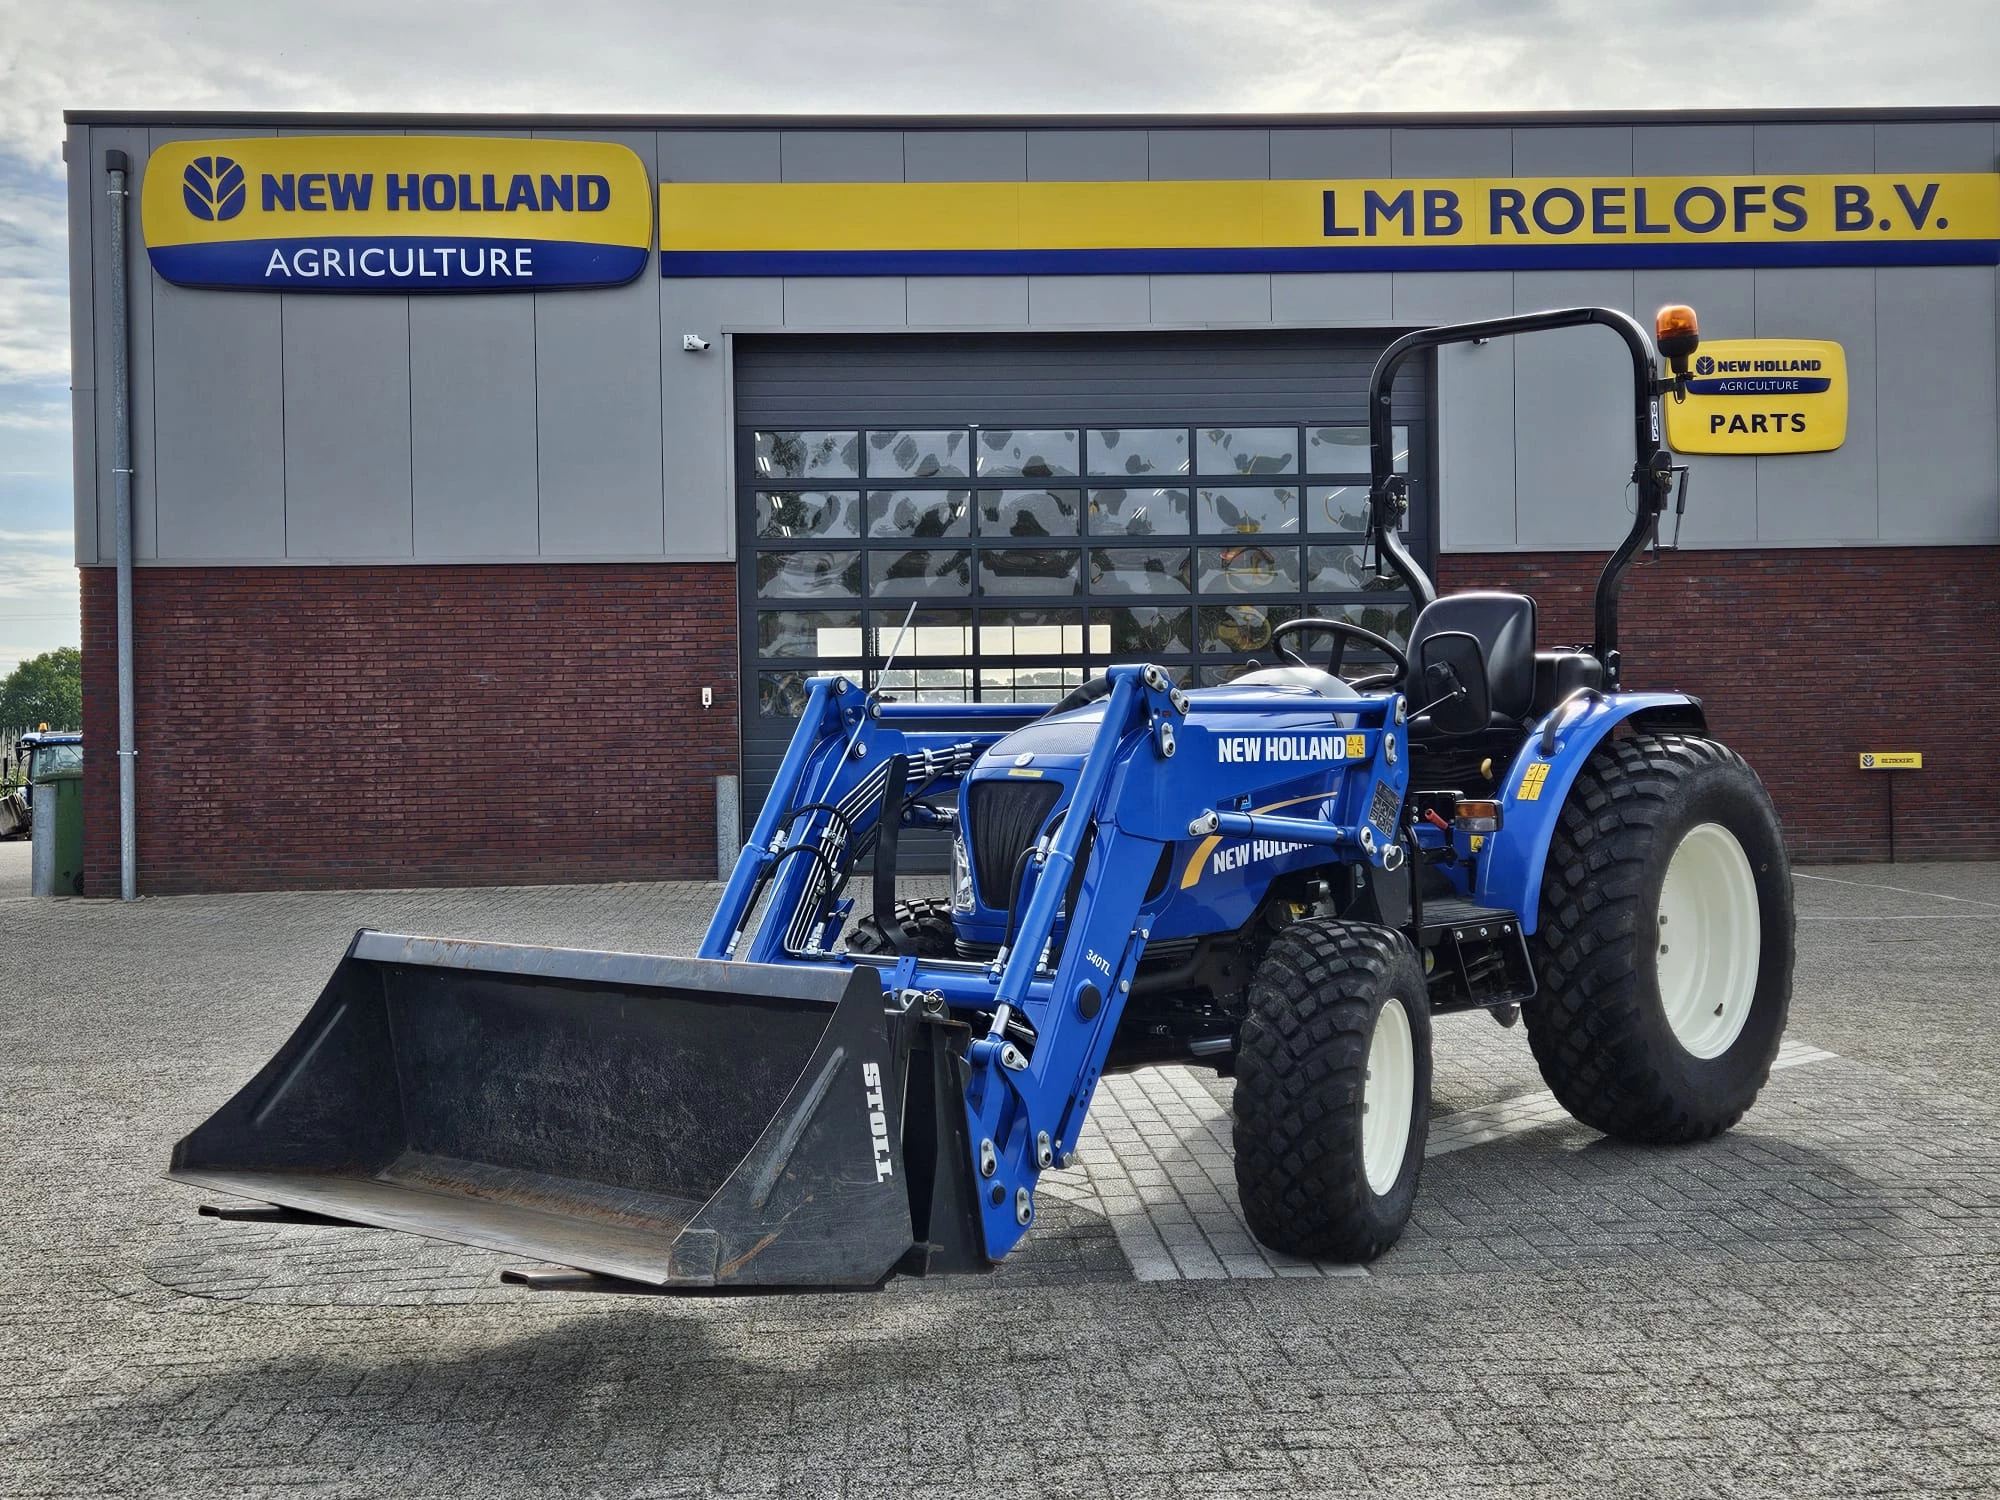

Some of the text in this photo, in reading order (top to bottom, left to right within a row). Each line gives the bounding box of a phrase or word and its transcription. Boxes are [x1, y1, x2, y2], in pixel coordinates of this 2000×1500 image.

[262, 174, 611, 213] NEW HOLLAND
[1322, 183, 1950, 237] LMB ROELOFS B.V.
[265, 248, 533, 277] AGRICULTURE
[1717, 359, 1822, 373] NEW HOLLAND
[1719, 380, 1799, 391] AGRICULTURE
[1710, 413, 1806, 434] PARTS
[1218, 736, 1347, 763] NEW HOLLAND
[1213, 843, 1250, 875] NEW
[1086, 949, 1111, 977] 340TL
[862, 1062, 893, 1183] STOLL
